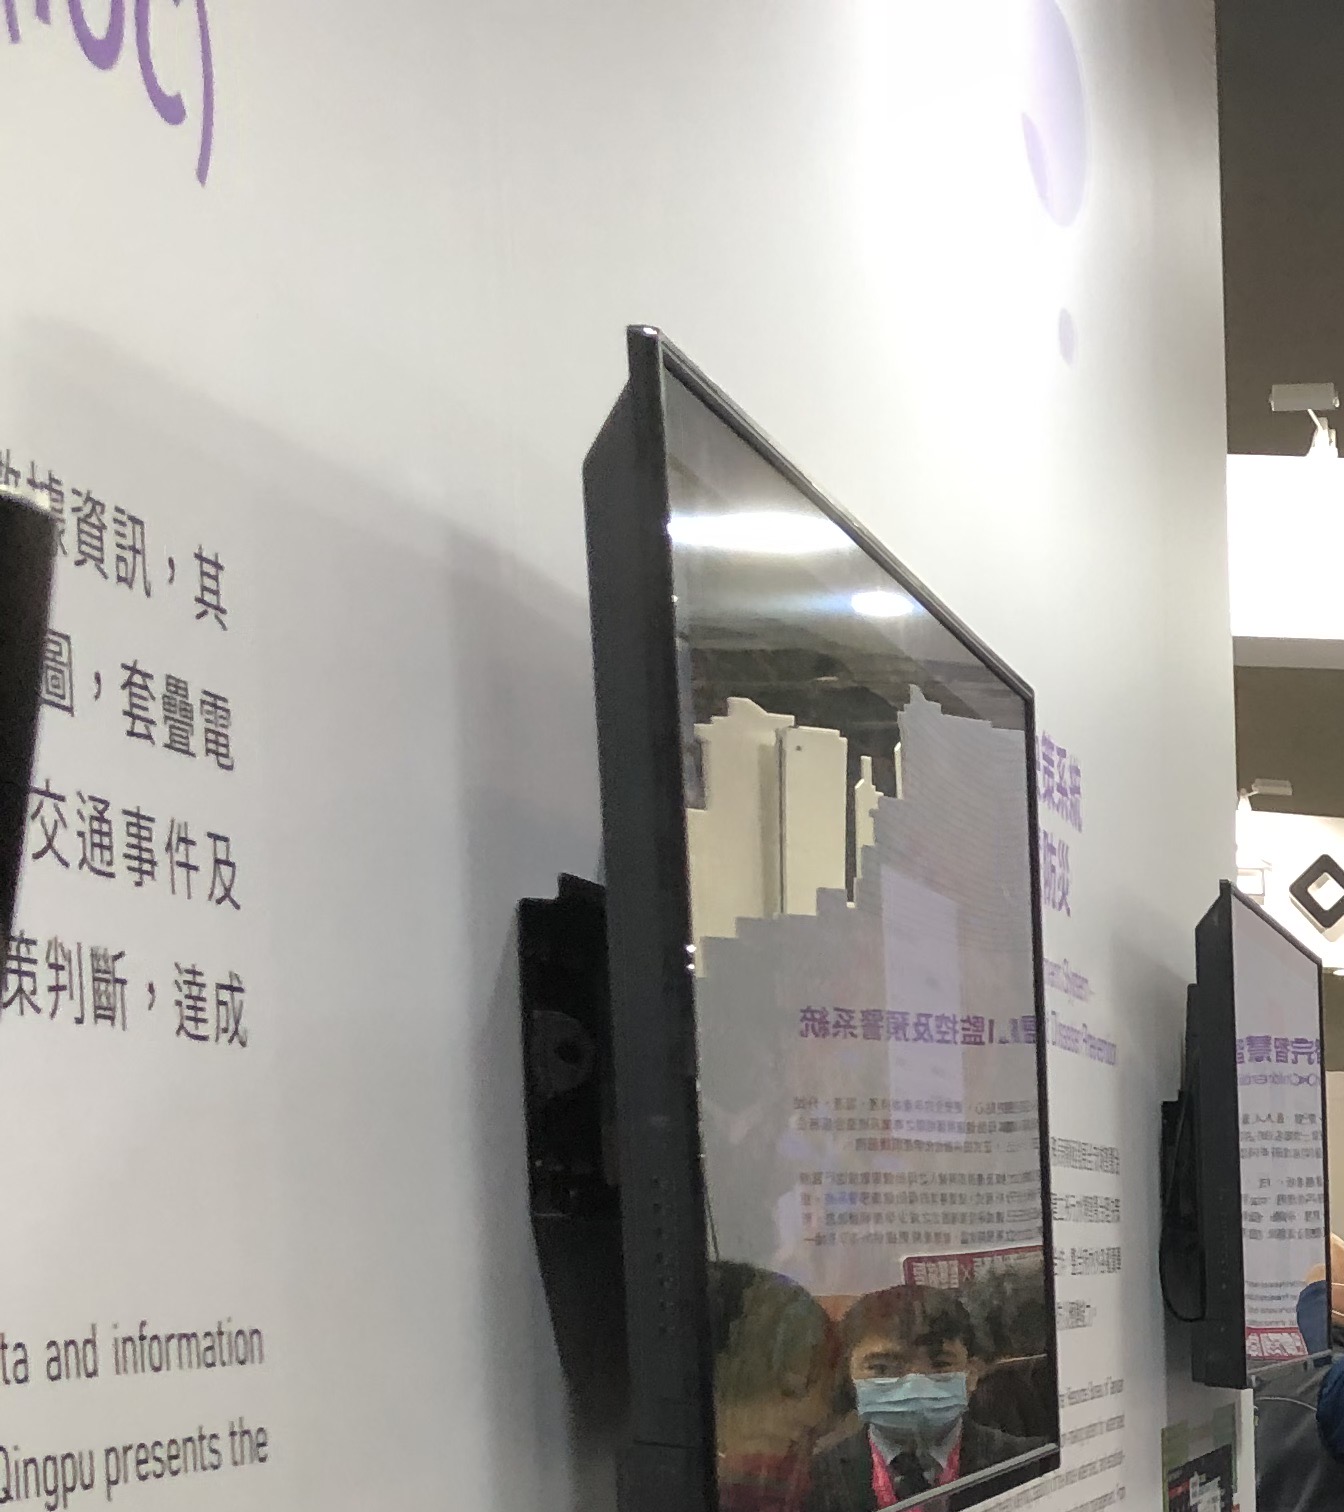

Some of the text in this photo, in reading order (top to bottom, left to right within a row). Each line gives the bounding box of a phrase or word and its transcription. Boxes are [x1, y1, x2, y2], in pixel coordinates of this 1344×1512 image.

[30, 778, 241, 910] 交通事件及
[46, 1322, 98, 1382] and
[112, 1316, 264, 1376] information
[105, 1424, 223, 1502] presents
[229, 1415, 269, 1467] the
